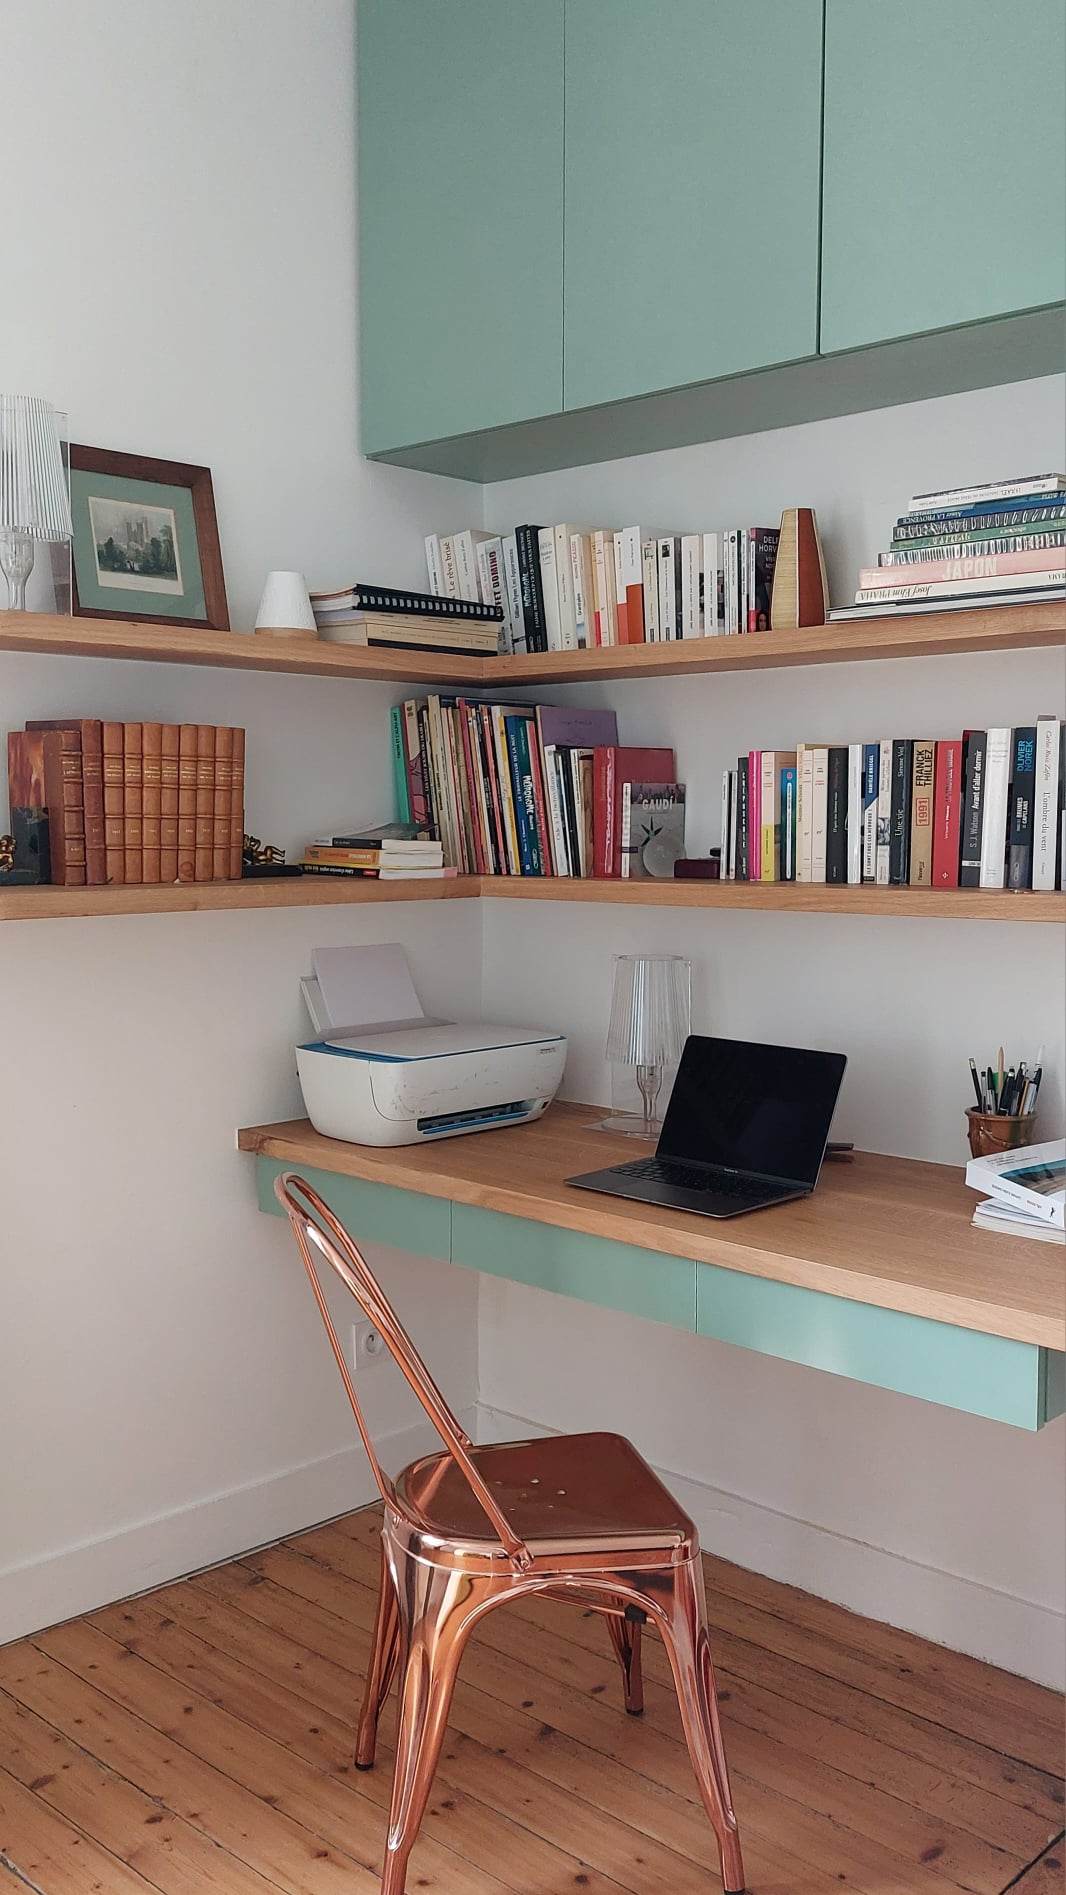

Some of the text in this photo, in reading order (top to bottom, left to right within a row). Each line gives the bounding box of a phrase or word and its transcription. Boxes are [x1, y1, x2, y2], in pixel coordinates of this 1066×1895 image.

[903, 514, 935, 524] PROVENCE
[443, 542, 451, 561] brisé
[489, 551, 499, 587] DOMINO
[944, 557, 997, 580] JAPON
[448, 581, 455, 591] Le
[911, 586, 932, 595] Josef
[974, 750, 982, 771] dormir
[1017, 740, 1026, 772] OLIVIER
[1025, 740, 1033, 772] NOREK
[916, 750, 924, 786] FRANCK
[924, 750, 932, 787] THILLIEZ
[972, 772, 981, 791] d'aller
[642, 796, 673, 811] GAUDÍ
[972, 792, 980, 809] Avant
[1042, 792, 1050, 822] L'ombre
[895, 809, 903, 820] vie
[918, 800, 927, 824] 1991
[894, 821, 903, 836] Une
[970, 811, 979, 835] Watson
[1041, 824, 1049, 834] du
